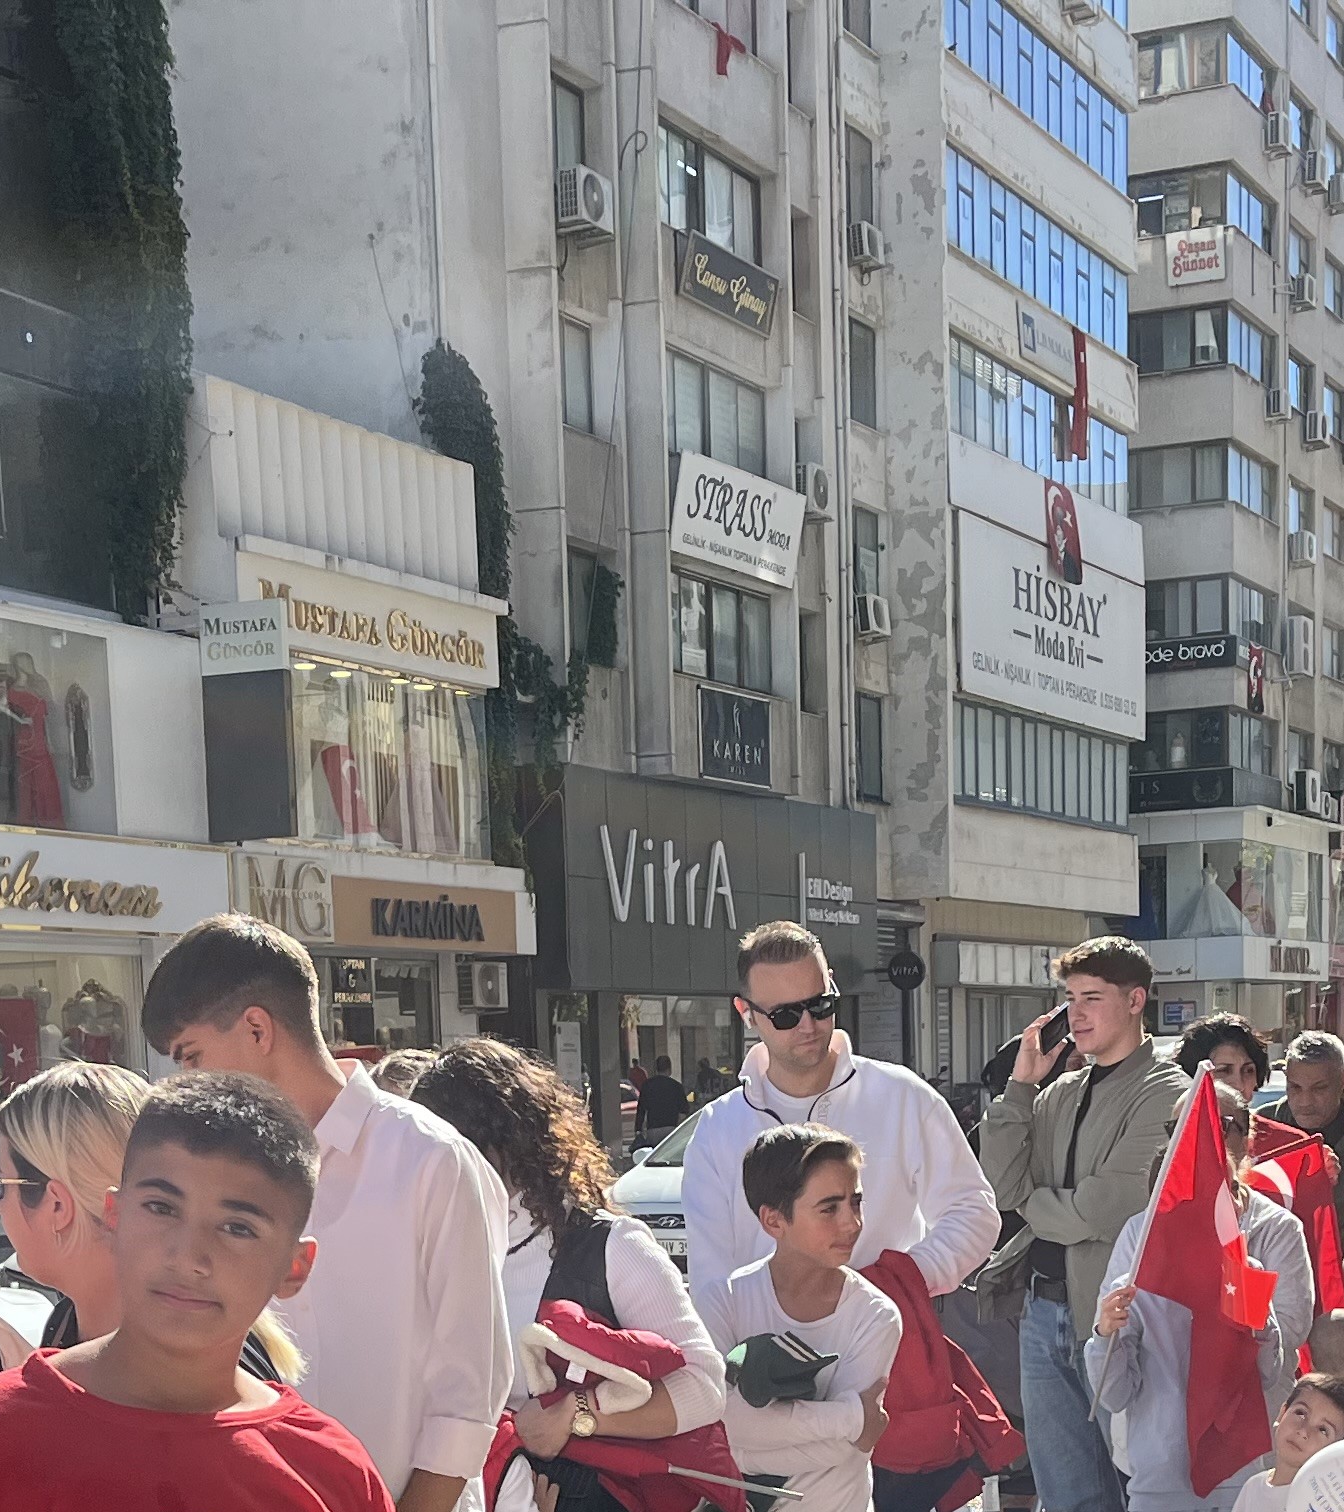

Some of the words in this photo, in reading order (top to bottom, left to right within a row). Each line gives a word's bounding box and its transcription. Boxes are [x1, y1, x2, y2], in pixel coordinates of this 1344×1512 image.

[1172, 255, 1220, 278] Sünnet
[687, 474, 772, 541] STRASS
[1011, 565, 1102, 638] HİSBAY
[203, 615, 278, 638] MUSTAFA
[386, 607, 488, 671] GÜNGÖR
[207, 639, 276, 662] GÜNGÖR
[1034, 625, 1065, 662] Moda
[1068, 637, 1085, 669] Evi
[1144, 647, 1174, 665] ode
[1178, 643, 1225, 661] bravo
[713, 738, 762, 766] KAREN
[599, 824, 737, 930] VitrA
[823, 880, 853, 906] Design
[369, 894, 486, 942] KARMİNA
